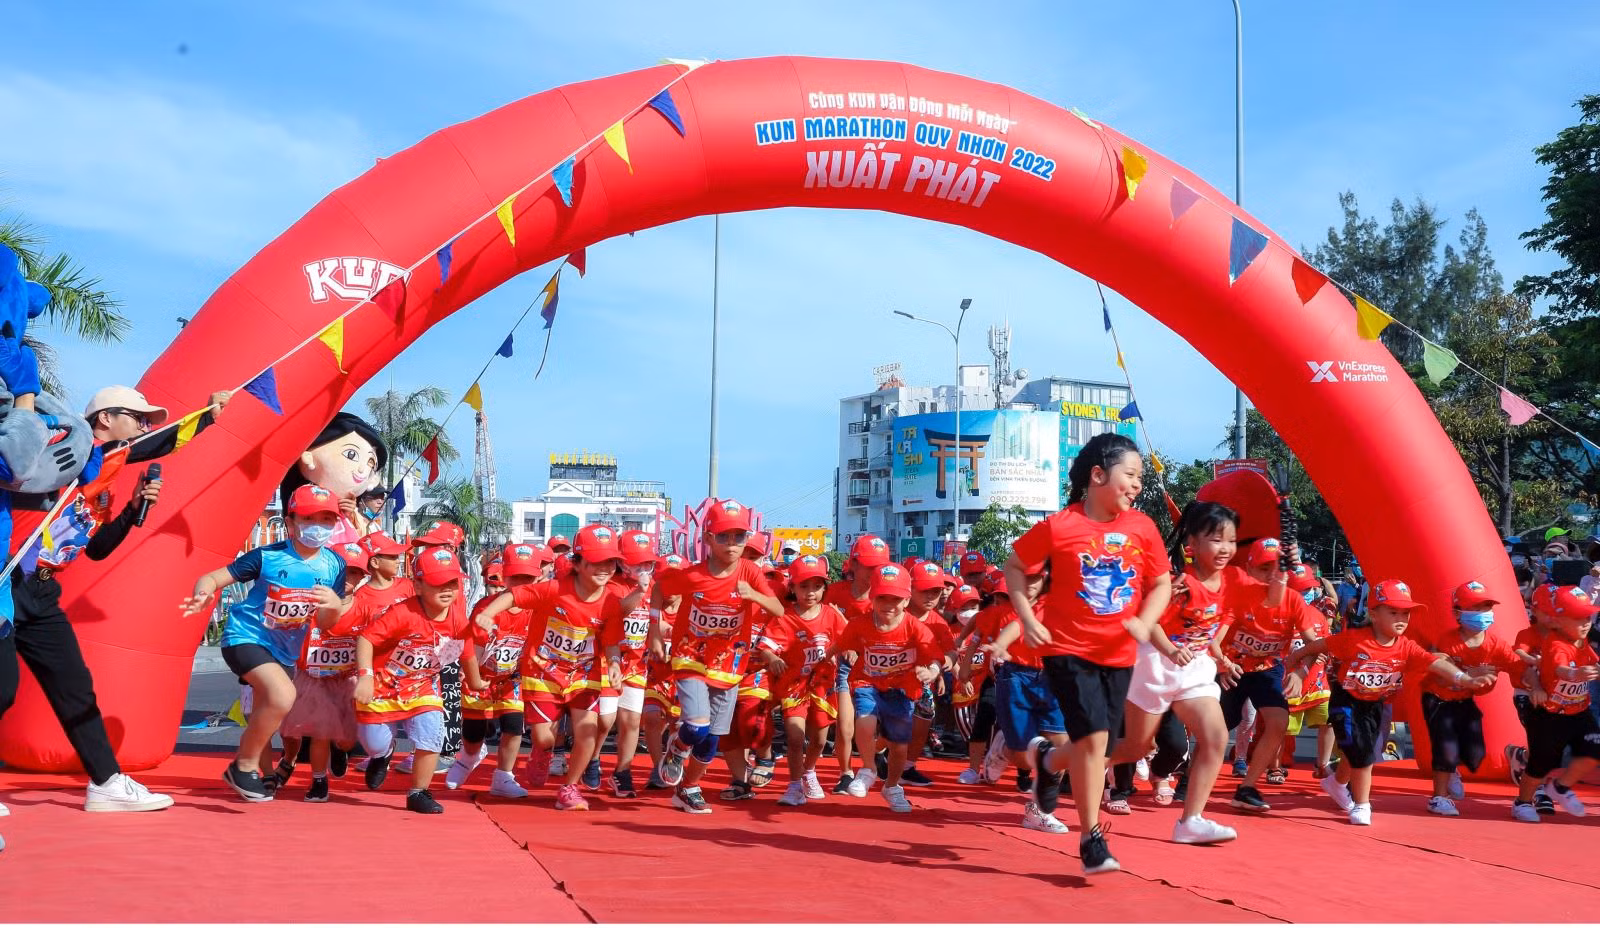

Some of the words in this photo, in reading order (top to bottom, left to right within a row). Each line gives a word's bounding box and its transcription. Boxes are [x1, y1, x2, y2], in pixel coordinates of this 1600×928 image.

[848, 92, 876, 109] KUN
[756, 120, 795, 144] KUN
[805, 117, 907, 141] MARATHON
[914, 122, 952, 147] QUY
[957, 131, 1006, 163] NHƠN
[1010, 148, 1056, 181] 2022
[804, 143, 902, 190] XUẤT
[904, 156, 1001, 208] PHÁT
[1338, 361, 1386, 373] VnExpress
[1343, 373, 1388, 382] Marathon
[1062, 401, 1101, 418] SYDNEY
[1105, 408, 1136, 425] FRU
[692, 609, 739, 628] 10386
[1237, 633, 1280, 651] 10381
